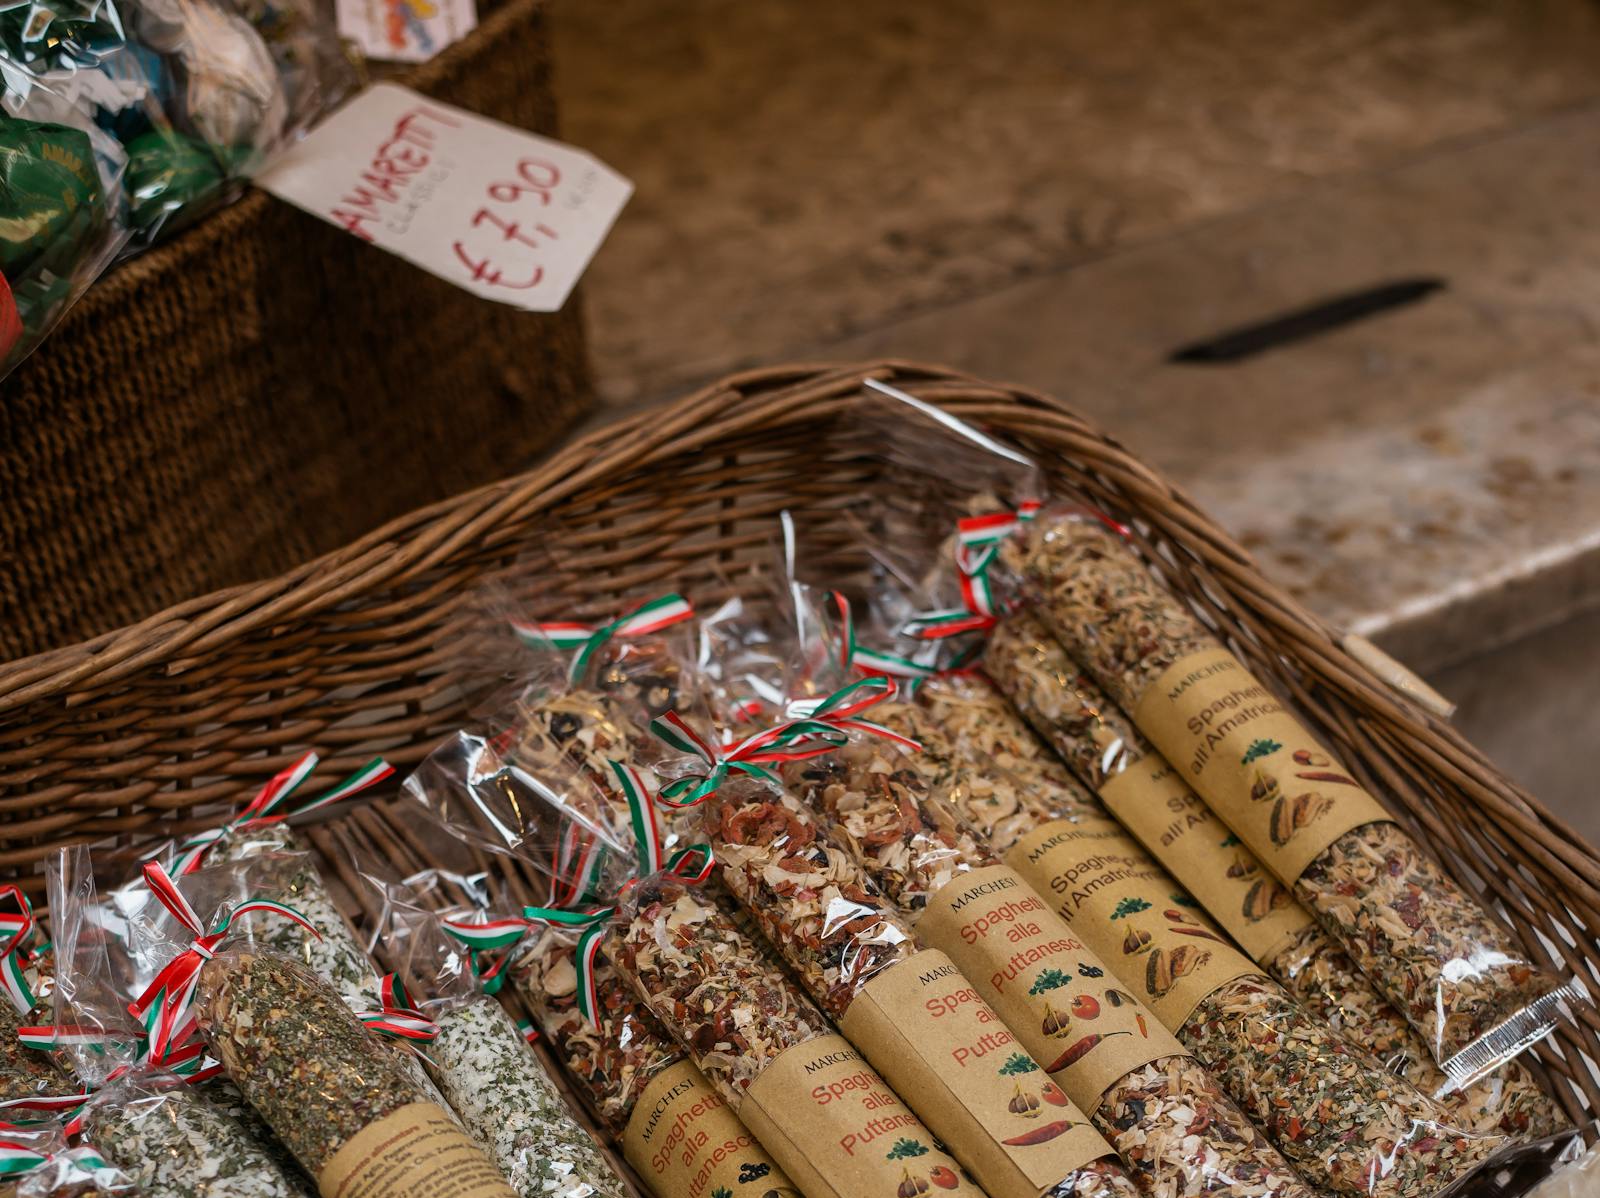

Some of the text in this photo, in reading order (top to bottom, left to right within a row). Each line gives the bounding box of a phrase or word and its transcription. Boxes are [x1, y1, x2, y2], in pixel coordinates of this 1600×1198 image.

[1006, 921, 1042, 944] alla
[642, 1078, 696, 1144] MARCHESI
[862, 1091, 896, 1111] alla
[652, 1091, 727, 1175] Spaghetti
[681, 1130, 710, 1168] alla
[839, 1112, 918, 1157] Puttane
